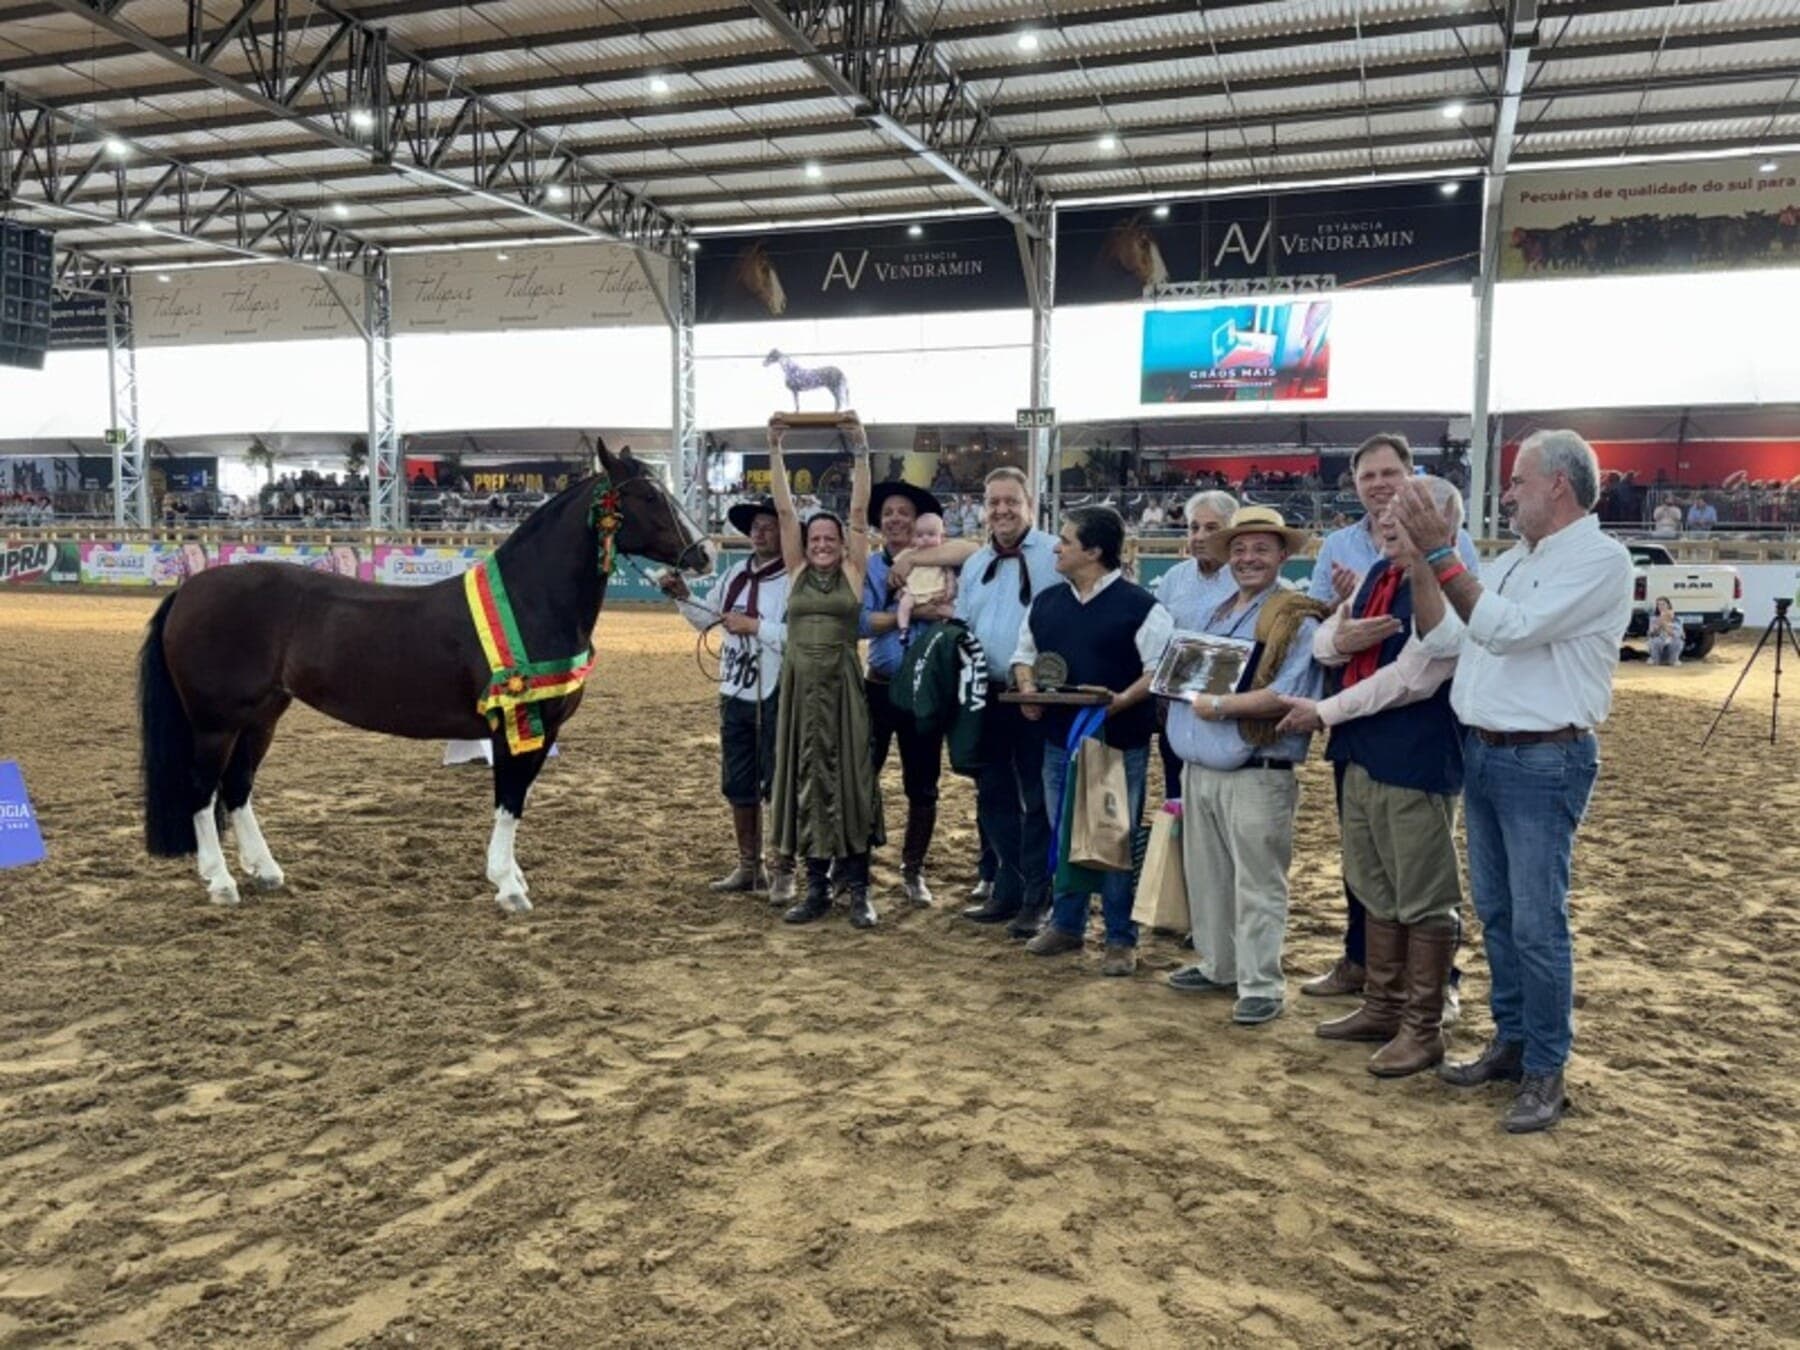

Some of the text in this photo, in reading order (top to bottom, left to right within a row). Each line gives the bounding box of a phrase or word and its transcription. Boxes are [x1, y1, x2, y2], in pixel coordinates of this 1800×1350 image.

[1520, 177, 1797, 203] Pecuária de qualidade do sul para
[821, 250, 869, 291] AV
[1241, 368, 1277, 378] MAIS
[1674, 582, 1713, 590] RAM
